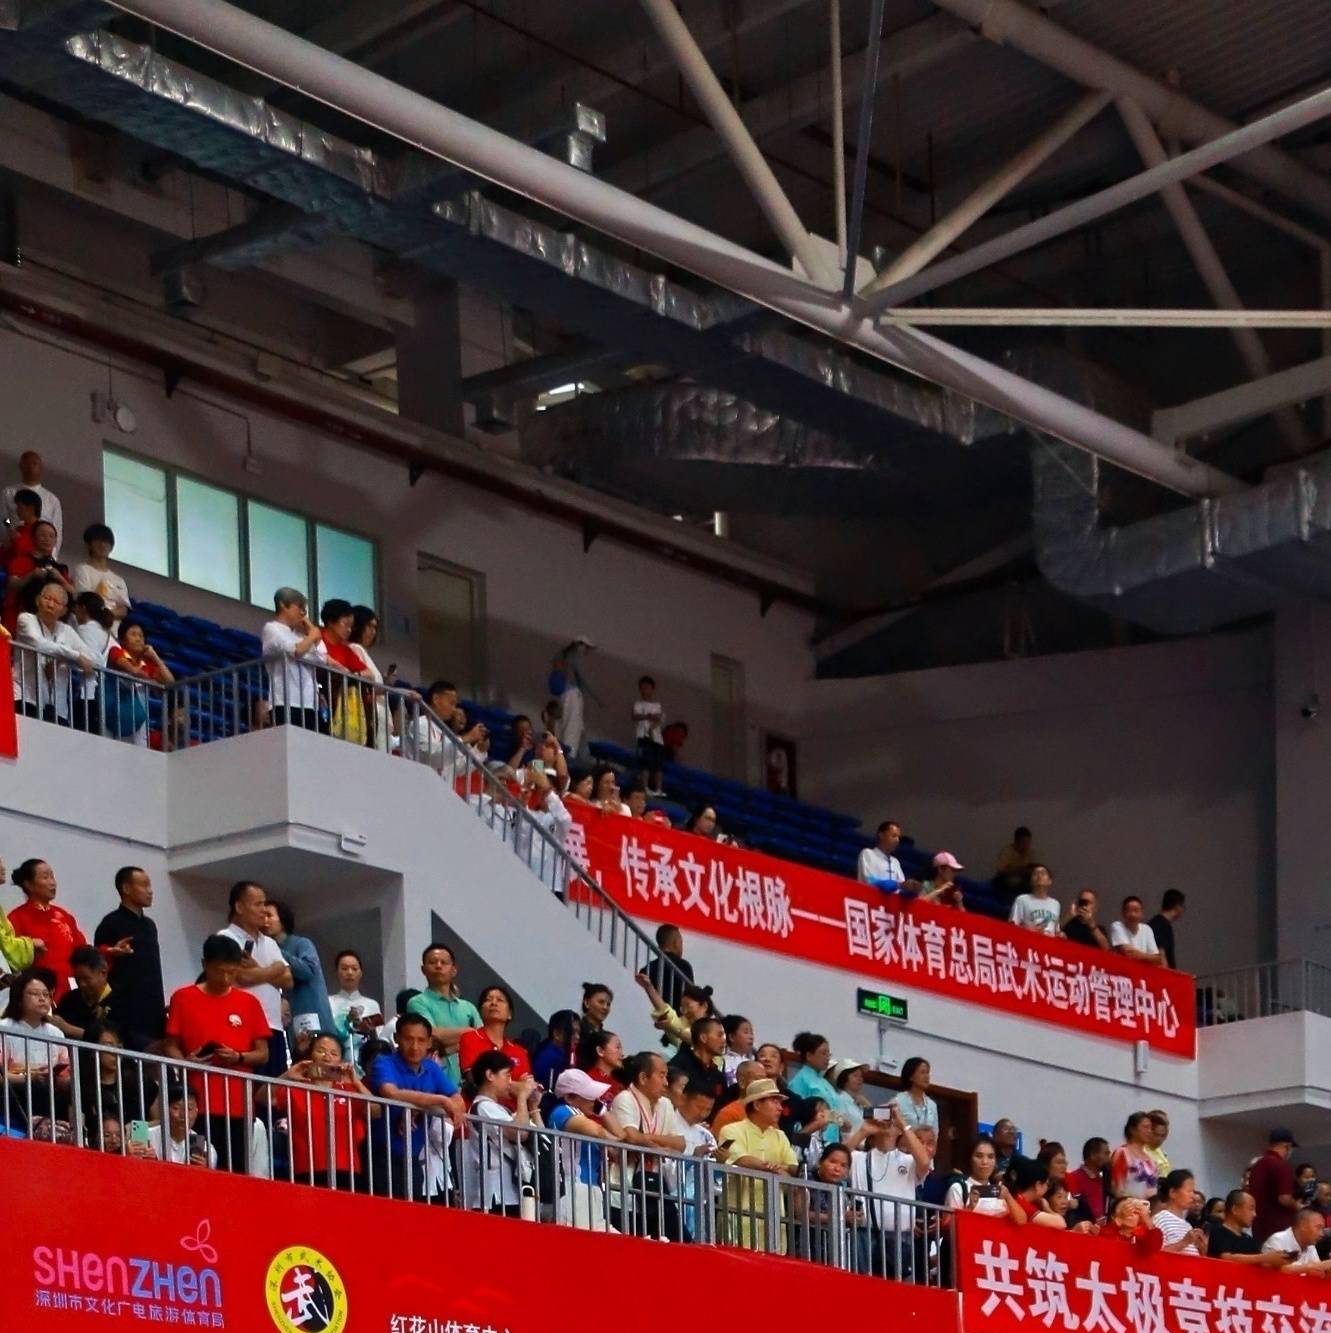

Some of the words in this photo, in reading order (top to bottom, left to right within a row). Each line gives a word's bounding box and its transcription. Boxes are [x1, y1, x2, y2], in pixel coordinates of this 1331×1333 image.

[35, 1289, 225, 1329] 深圳市文化广电旅游体育局
